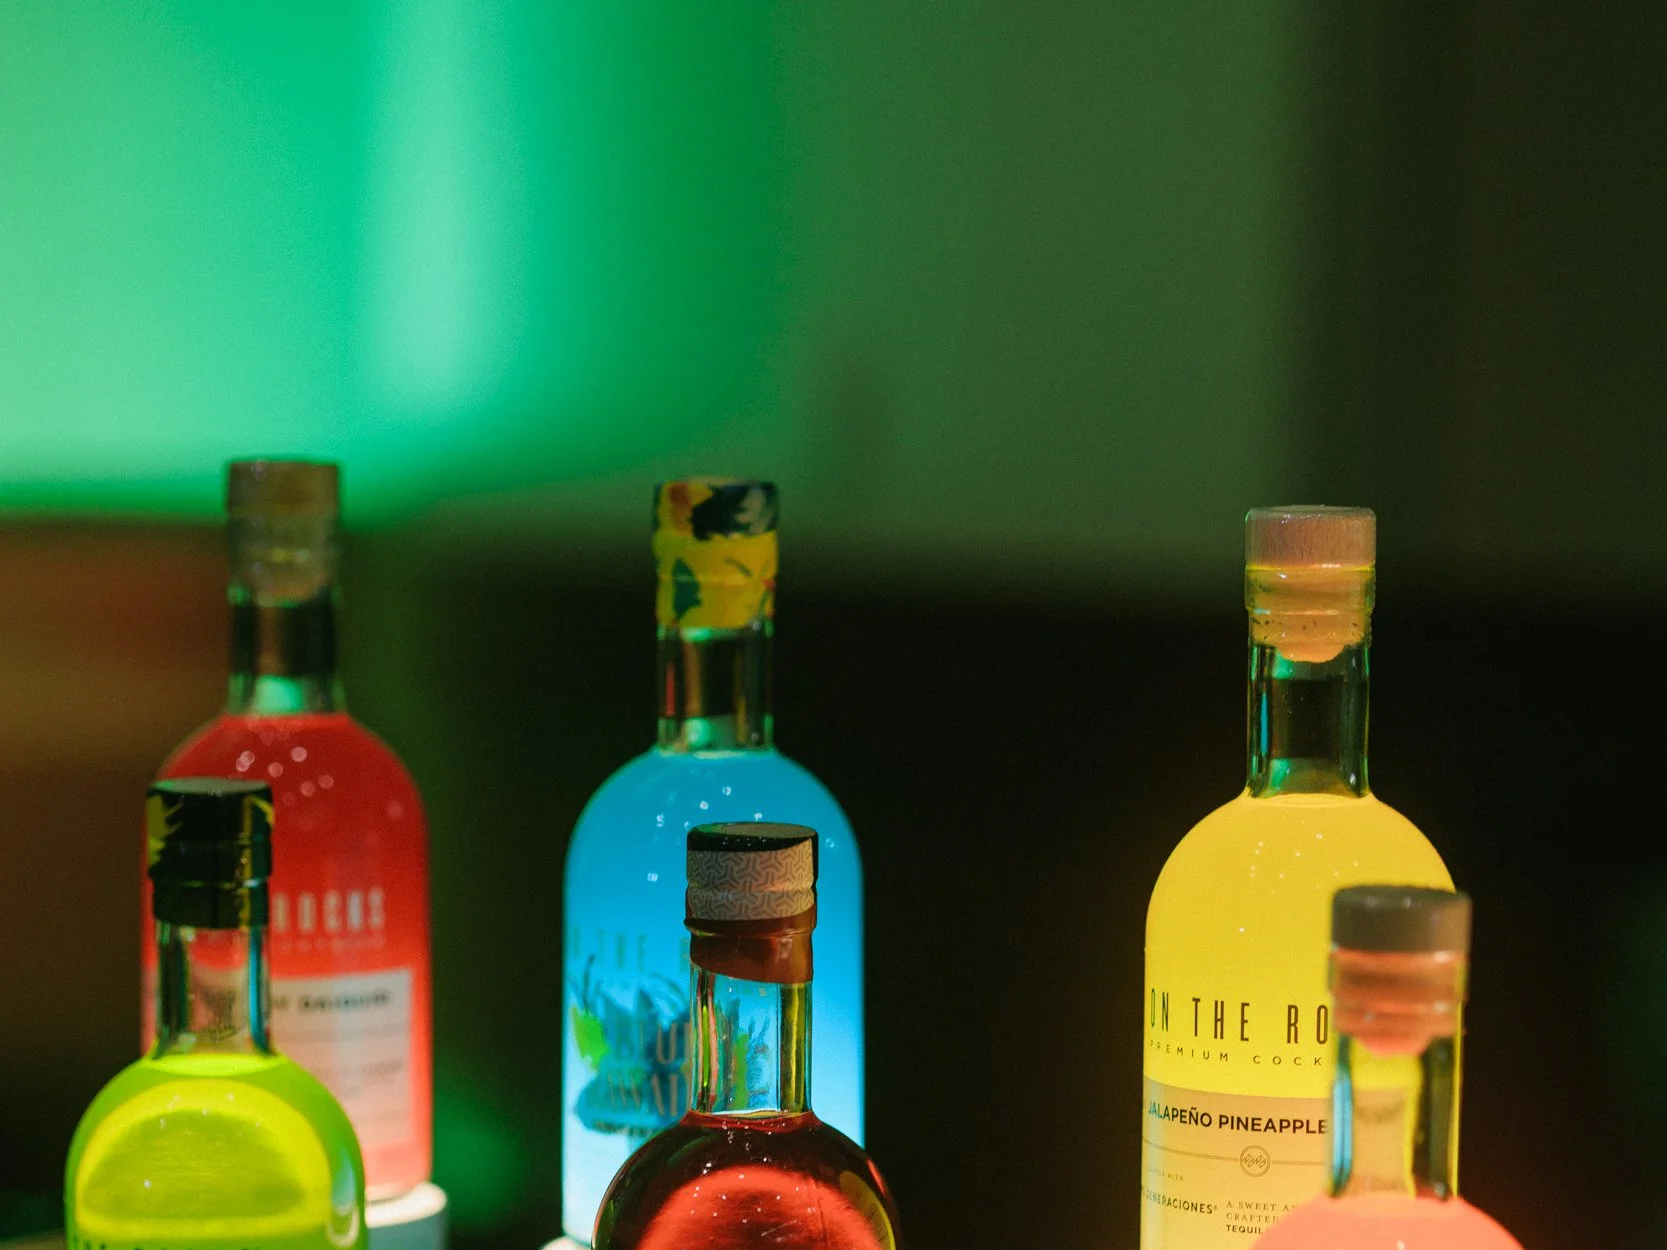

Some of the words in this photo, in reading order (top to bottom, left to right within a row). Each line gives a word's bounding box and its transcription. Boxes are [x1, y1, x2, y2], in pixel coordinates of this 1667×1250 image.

[1150, 987, 1169, 1032] ON
[1192, 997, 1250, 1042] THE
[1148, 1100, 1212, 1128] JALAPEÑO
[1218, 1114, 1328, 1135] PINEAPPLE
[1238, 1201, 1279, 1212] SWEET
[1226, 1223, 1266, 1235] TEQUIL
